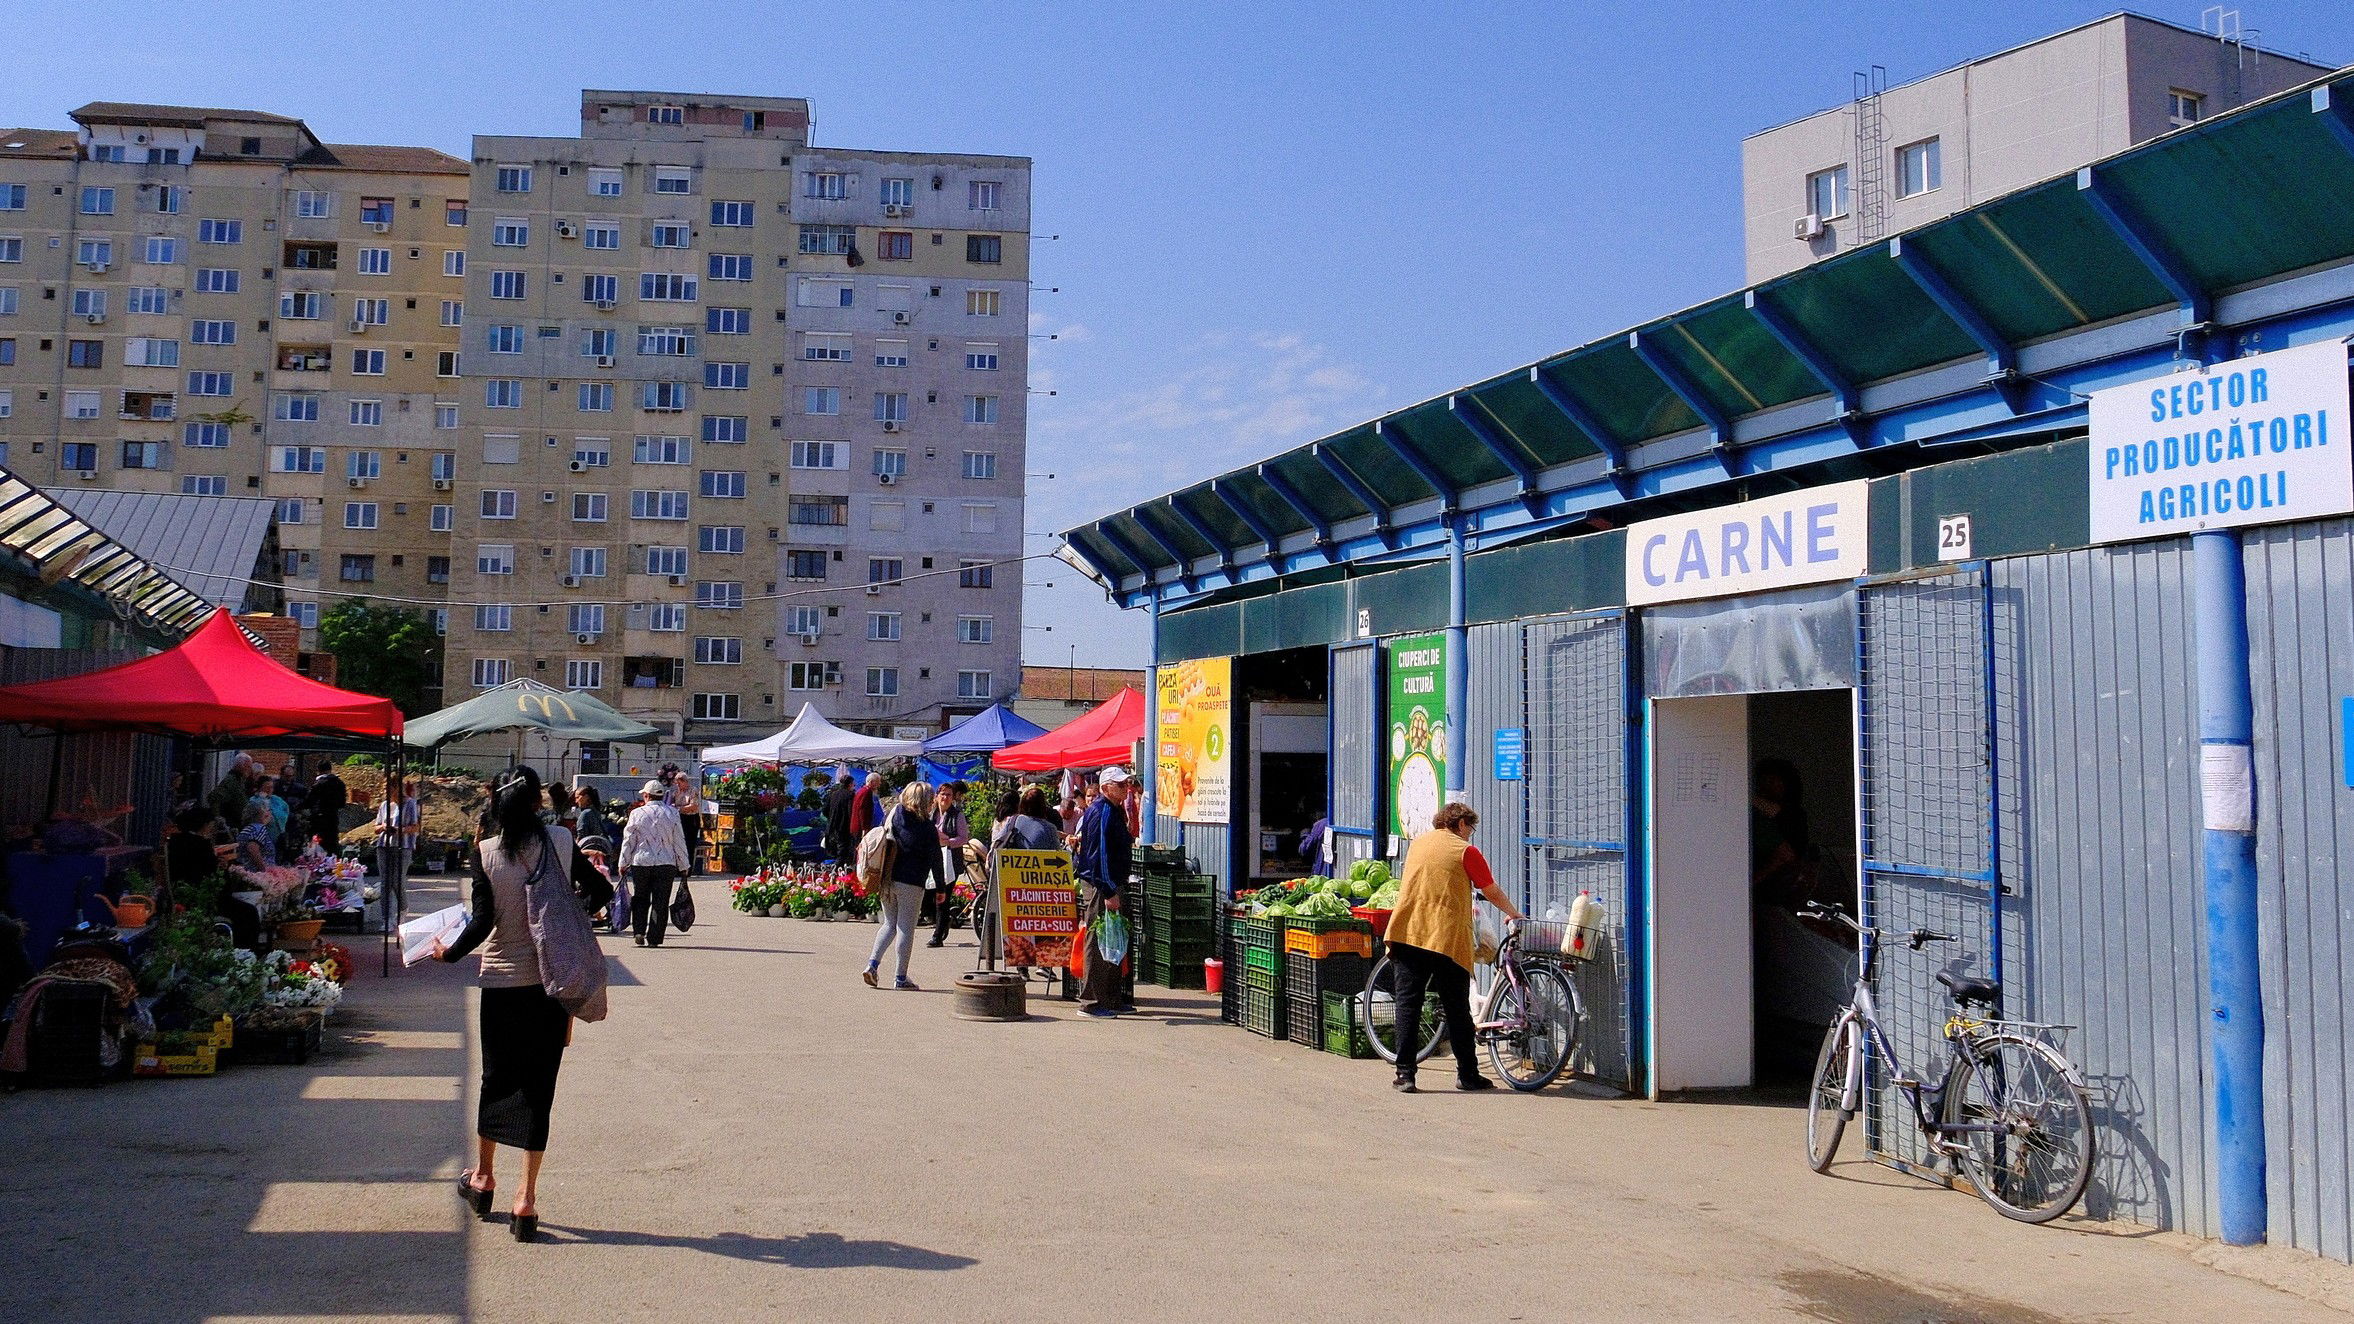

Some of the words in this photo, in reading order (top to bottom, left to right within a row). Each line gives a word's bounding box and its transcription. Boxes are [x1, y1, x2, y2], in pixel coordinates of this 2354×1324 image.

[2151, 367, 2268, 423] SECTOR
[2106, 409, 2328, 480] PRODUCĂTORI
[2139, 470, 2287, 524] AGRICOLI
[1642, 502, 1839, 587] CARNE
[1942, 522, 1967, 548] 25
[1360, 614, 1369, 629] 26
[1398, 648, 1430, 668] CIUPERCI
[1431, 648, 1440, 665] DE
[1205, 683, 1221, 698] OUĂ
[1403, 672, 1434, 694] CULTURĂ
[1197, 700, 1228, 711] PROASPETE
[1211, 733, 1219, 756] 2
[1001, 855, 1041, 869] PIZZA
[1021, 870, 1071, 888] URIAȘĂ
[1010, 889, 1051, 902] PLĂCINTE
[1016, 905, 1068, 916] PATISERIE
